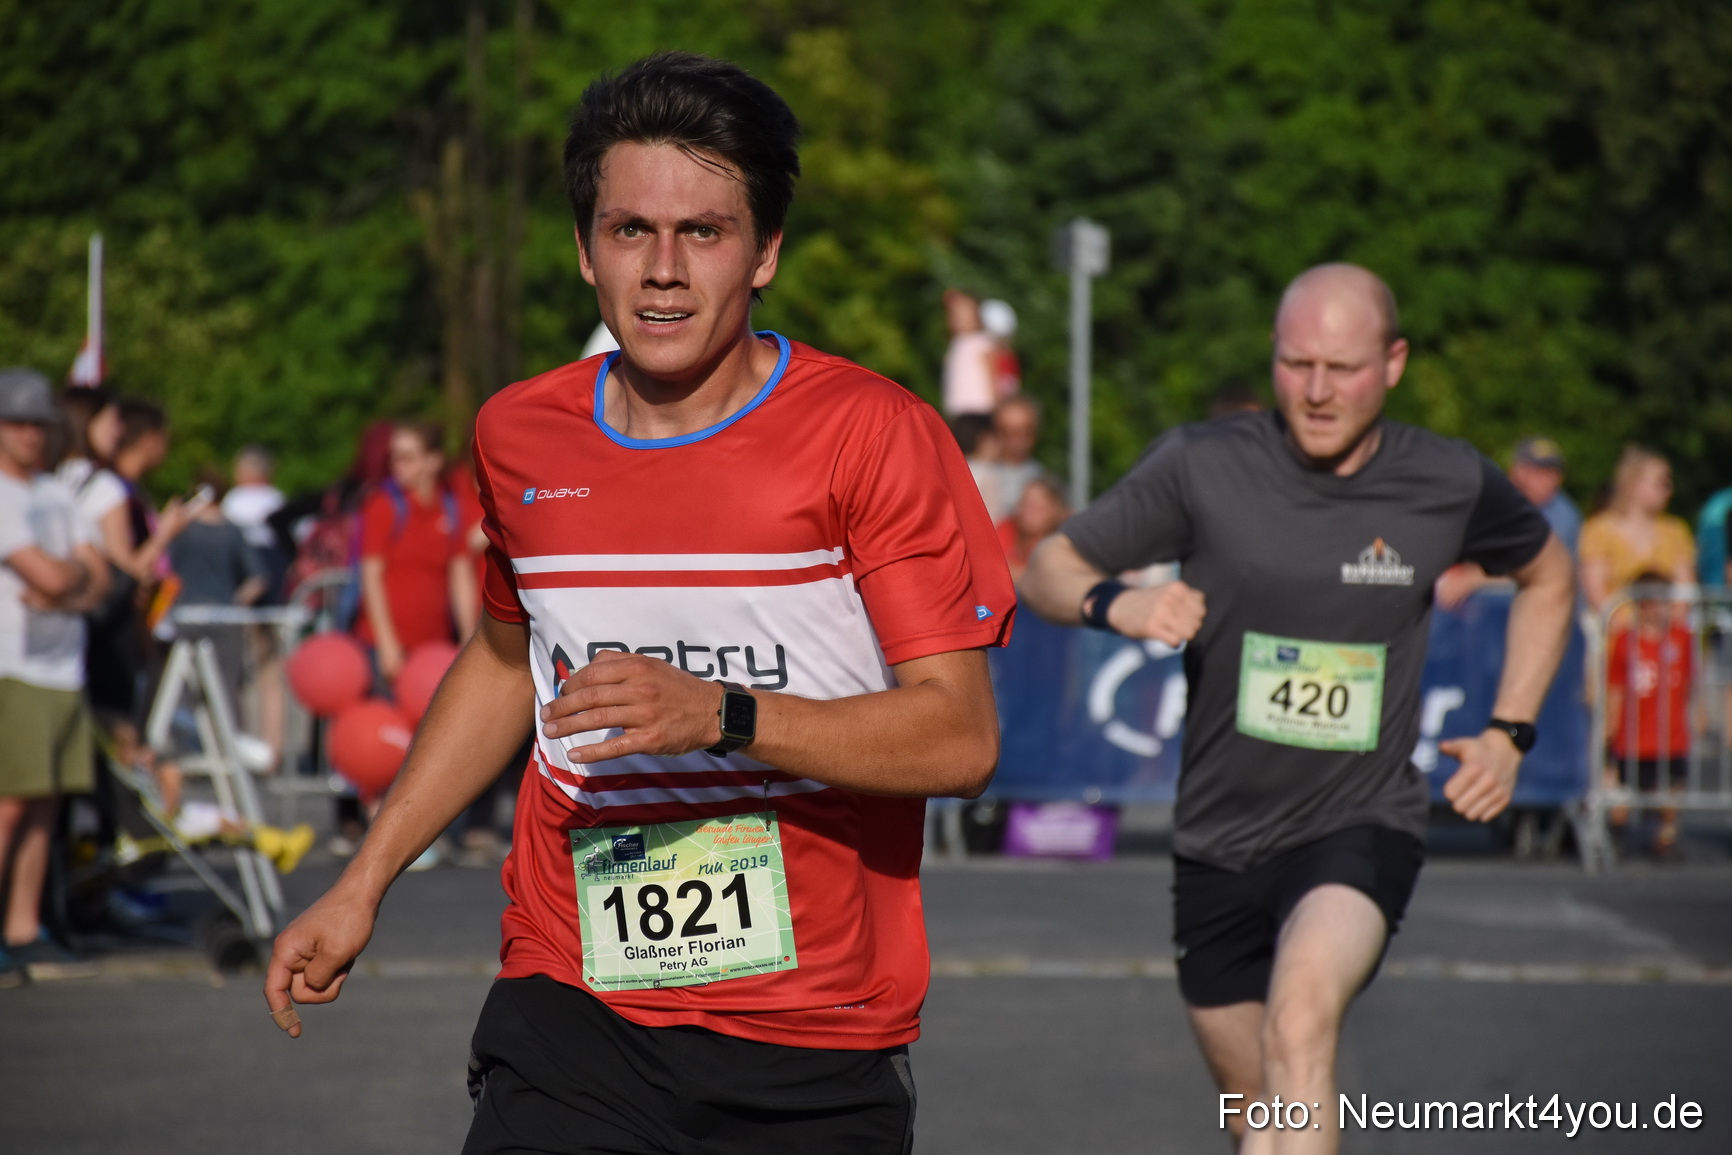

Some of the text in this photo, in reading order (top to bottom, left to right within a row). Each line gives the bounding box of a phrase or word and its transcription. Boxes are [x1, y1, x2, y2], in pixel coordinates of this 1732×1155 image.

[1270, 678, 1349, 718] 420
[735, 824, 765, 833] Firmen
[713, 834, 740, 845] laufen
[602, 853, 677, 874] firmenlauf
[698, 855, 768, 875] run 2019
[604, 873, 634, 881] neumarkt
[603, 873, 752, 942] 1821
[624, 937, 746, 960] Glaßner Florian
[660, 957, 708, 971] Petry AG
